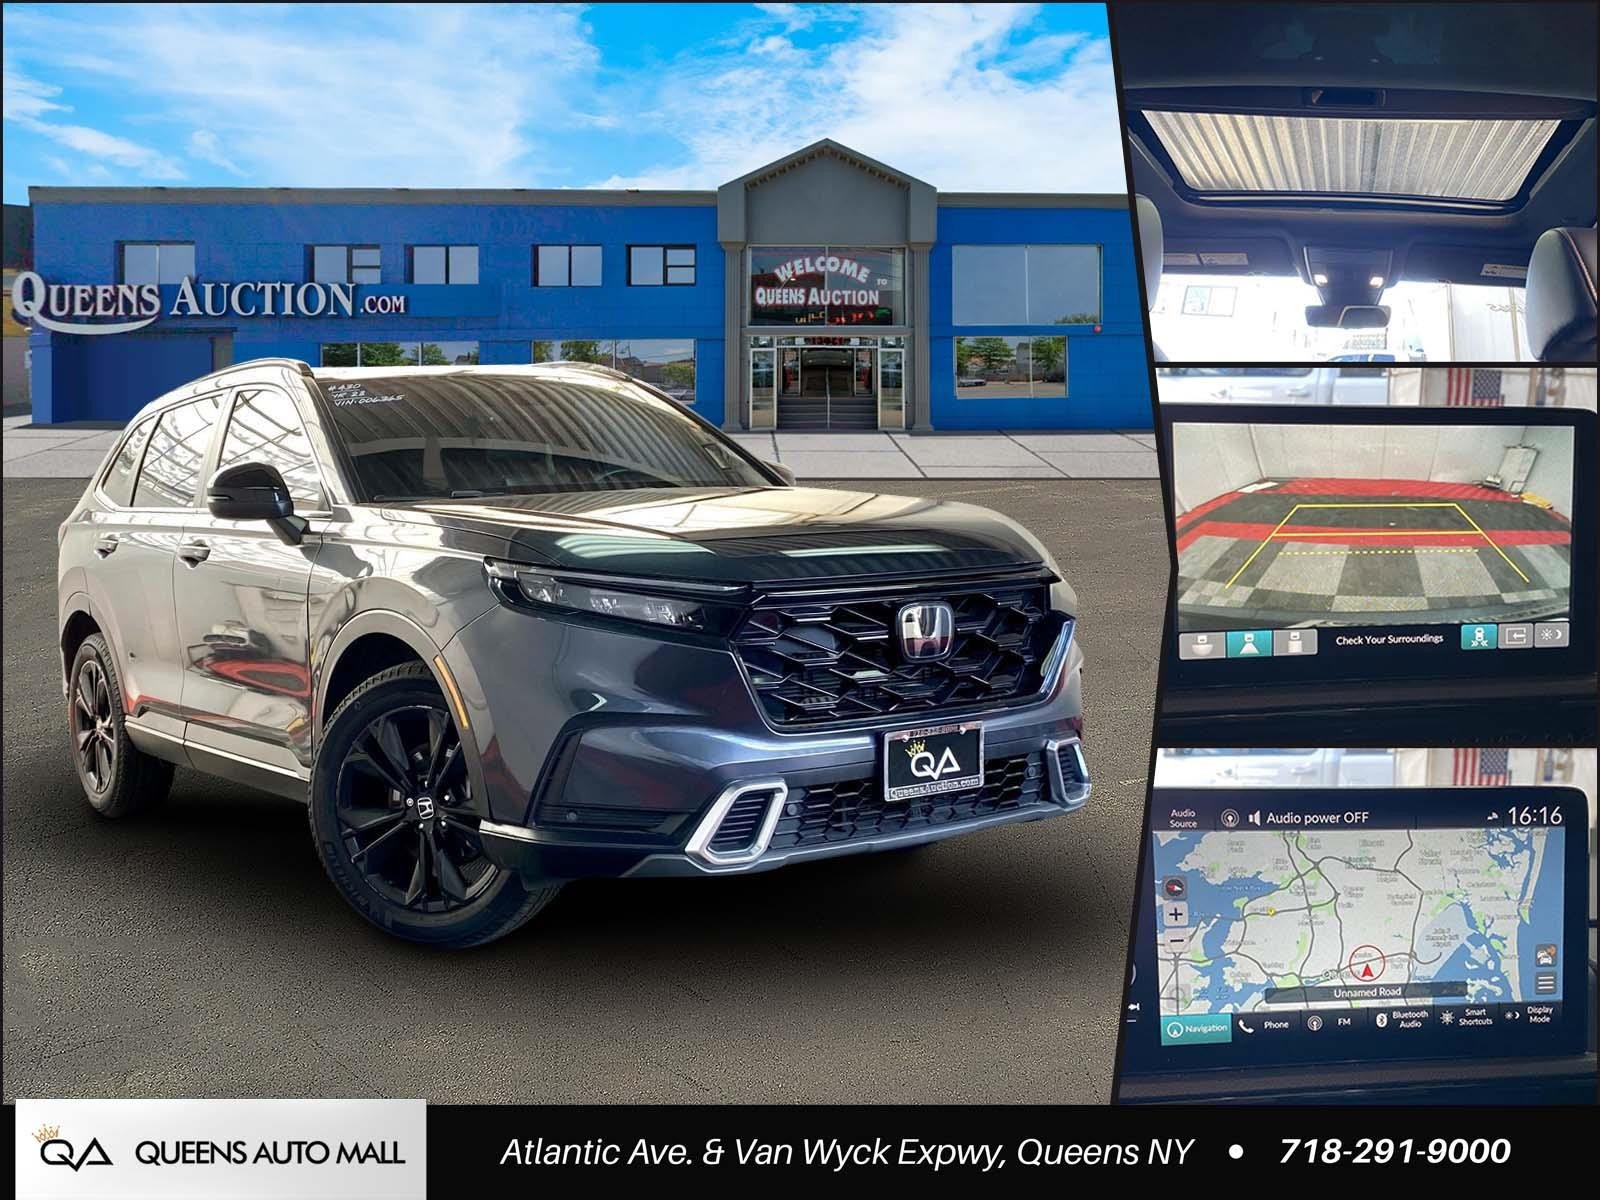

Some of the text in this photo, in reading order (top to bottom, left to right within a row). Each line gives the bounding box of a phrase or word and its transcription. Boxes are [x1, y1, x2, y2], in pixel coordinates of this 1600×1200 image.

[774, 256, 871, 284] WELCOME
[755, 287, 880, 305] QUEENS AUCTION
[11, 271, 160, 335] QUEENS
[1336, 634, 1444, 646] Check Your Surroundings
[1170, 809, 1196, 819] Audio
[1508, 806, 1563, 825] 16:16
[1170, 820, 1198, 829] Source
[1266, 811, 1369, 828] Audio power OFF
[1334, 987, 1401, 998] Unnamed Road
[1392, 1010, 1429, 1019] Bluetooth
[1465, 1009, 1487, 1017] Smart
[1527, 1006, 1554, 1017] Display
[1264, 1019, 1289, 1029] Phone
[1337, 1017, 1351, 1026] FM
[1400, 1020, 1422, 1028] Audio
[1459, 1018, 1493, 1026] Shortcuts
[1529, 1015, 1551, 1024] Mode
[1185, 1023, 1228, 1035] Navigation
